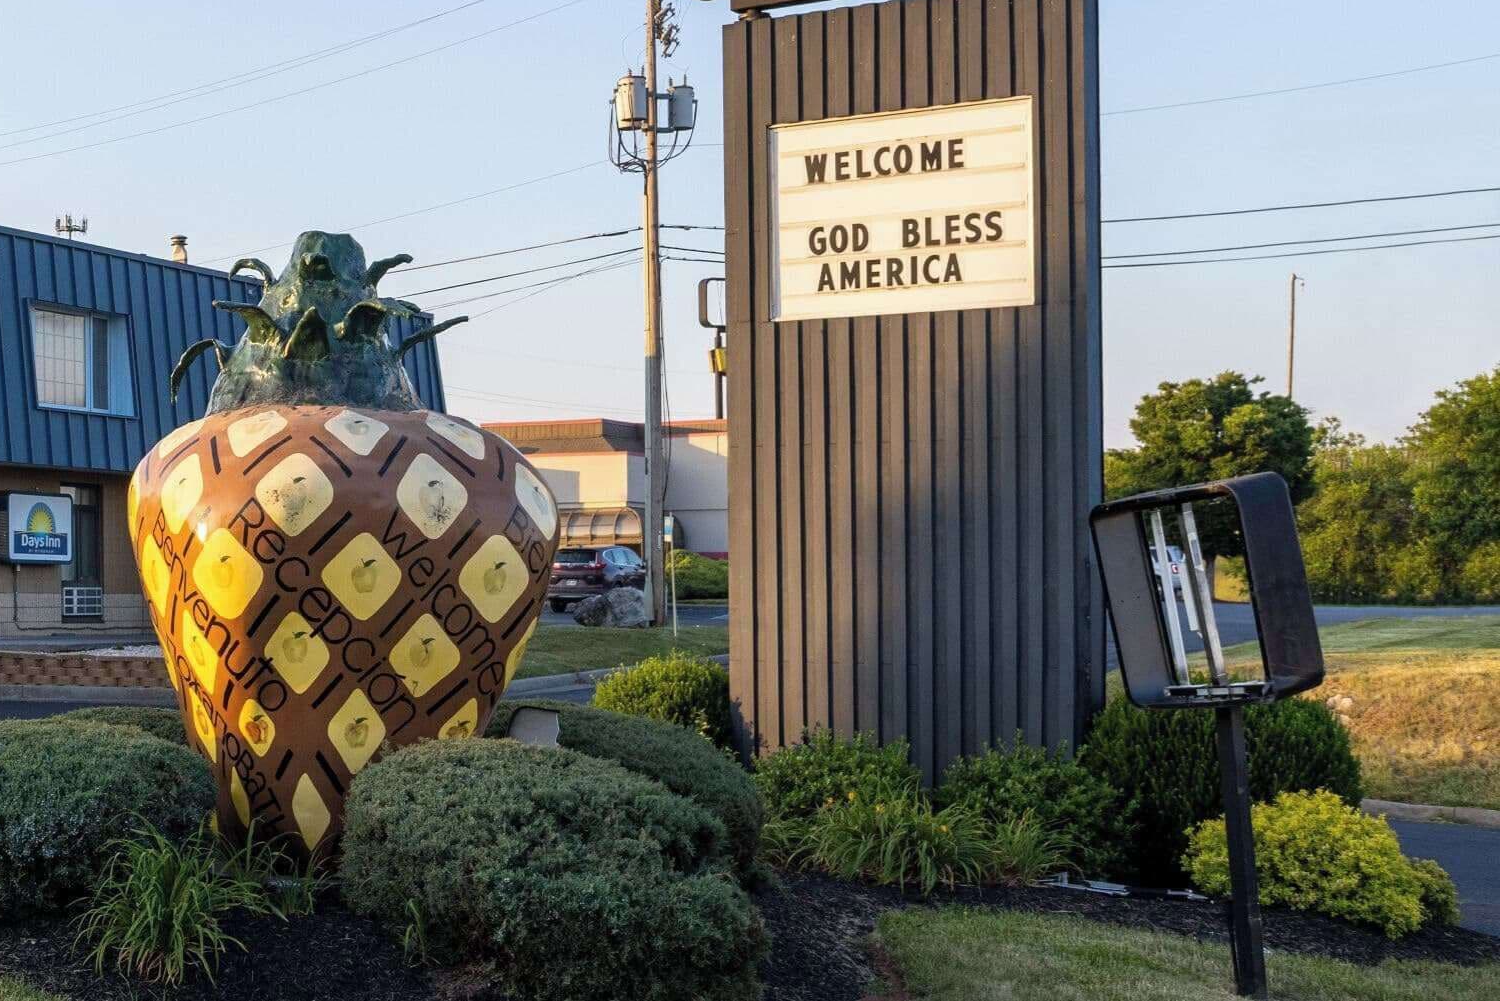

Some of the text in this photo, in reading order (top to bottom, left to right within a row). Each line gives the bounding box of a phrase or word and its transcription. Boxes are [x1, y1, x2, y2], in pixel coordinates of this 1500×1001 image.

[804, 138, 964, 184] WELCOME
[808, 210, 1004, 256] GOD BLESS
[817, 253, 963, 292] AMERICA
[21, 533, 61, 549] Days Inn
[152, 510, 287, 711] Benvenuto
[228, 497, 416, 737] Recepción
[382, 505, 505, 696] Welcome
